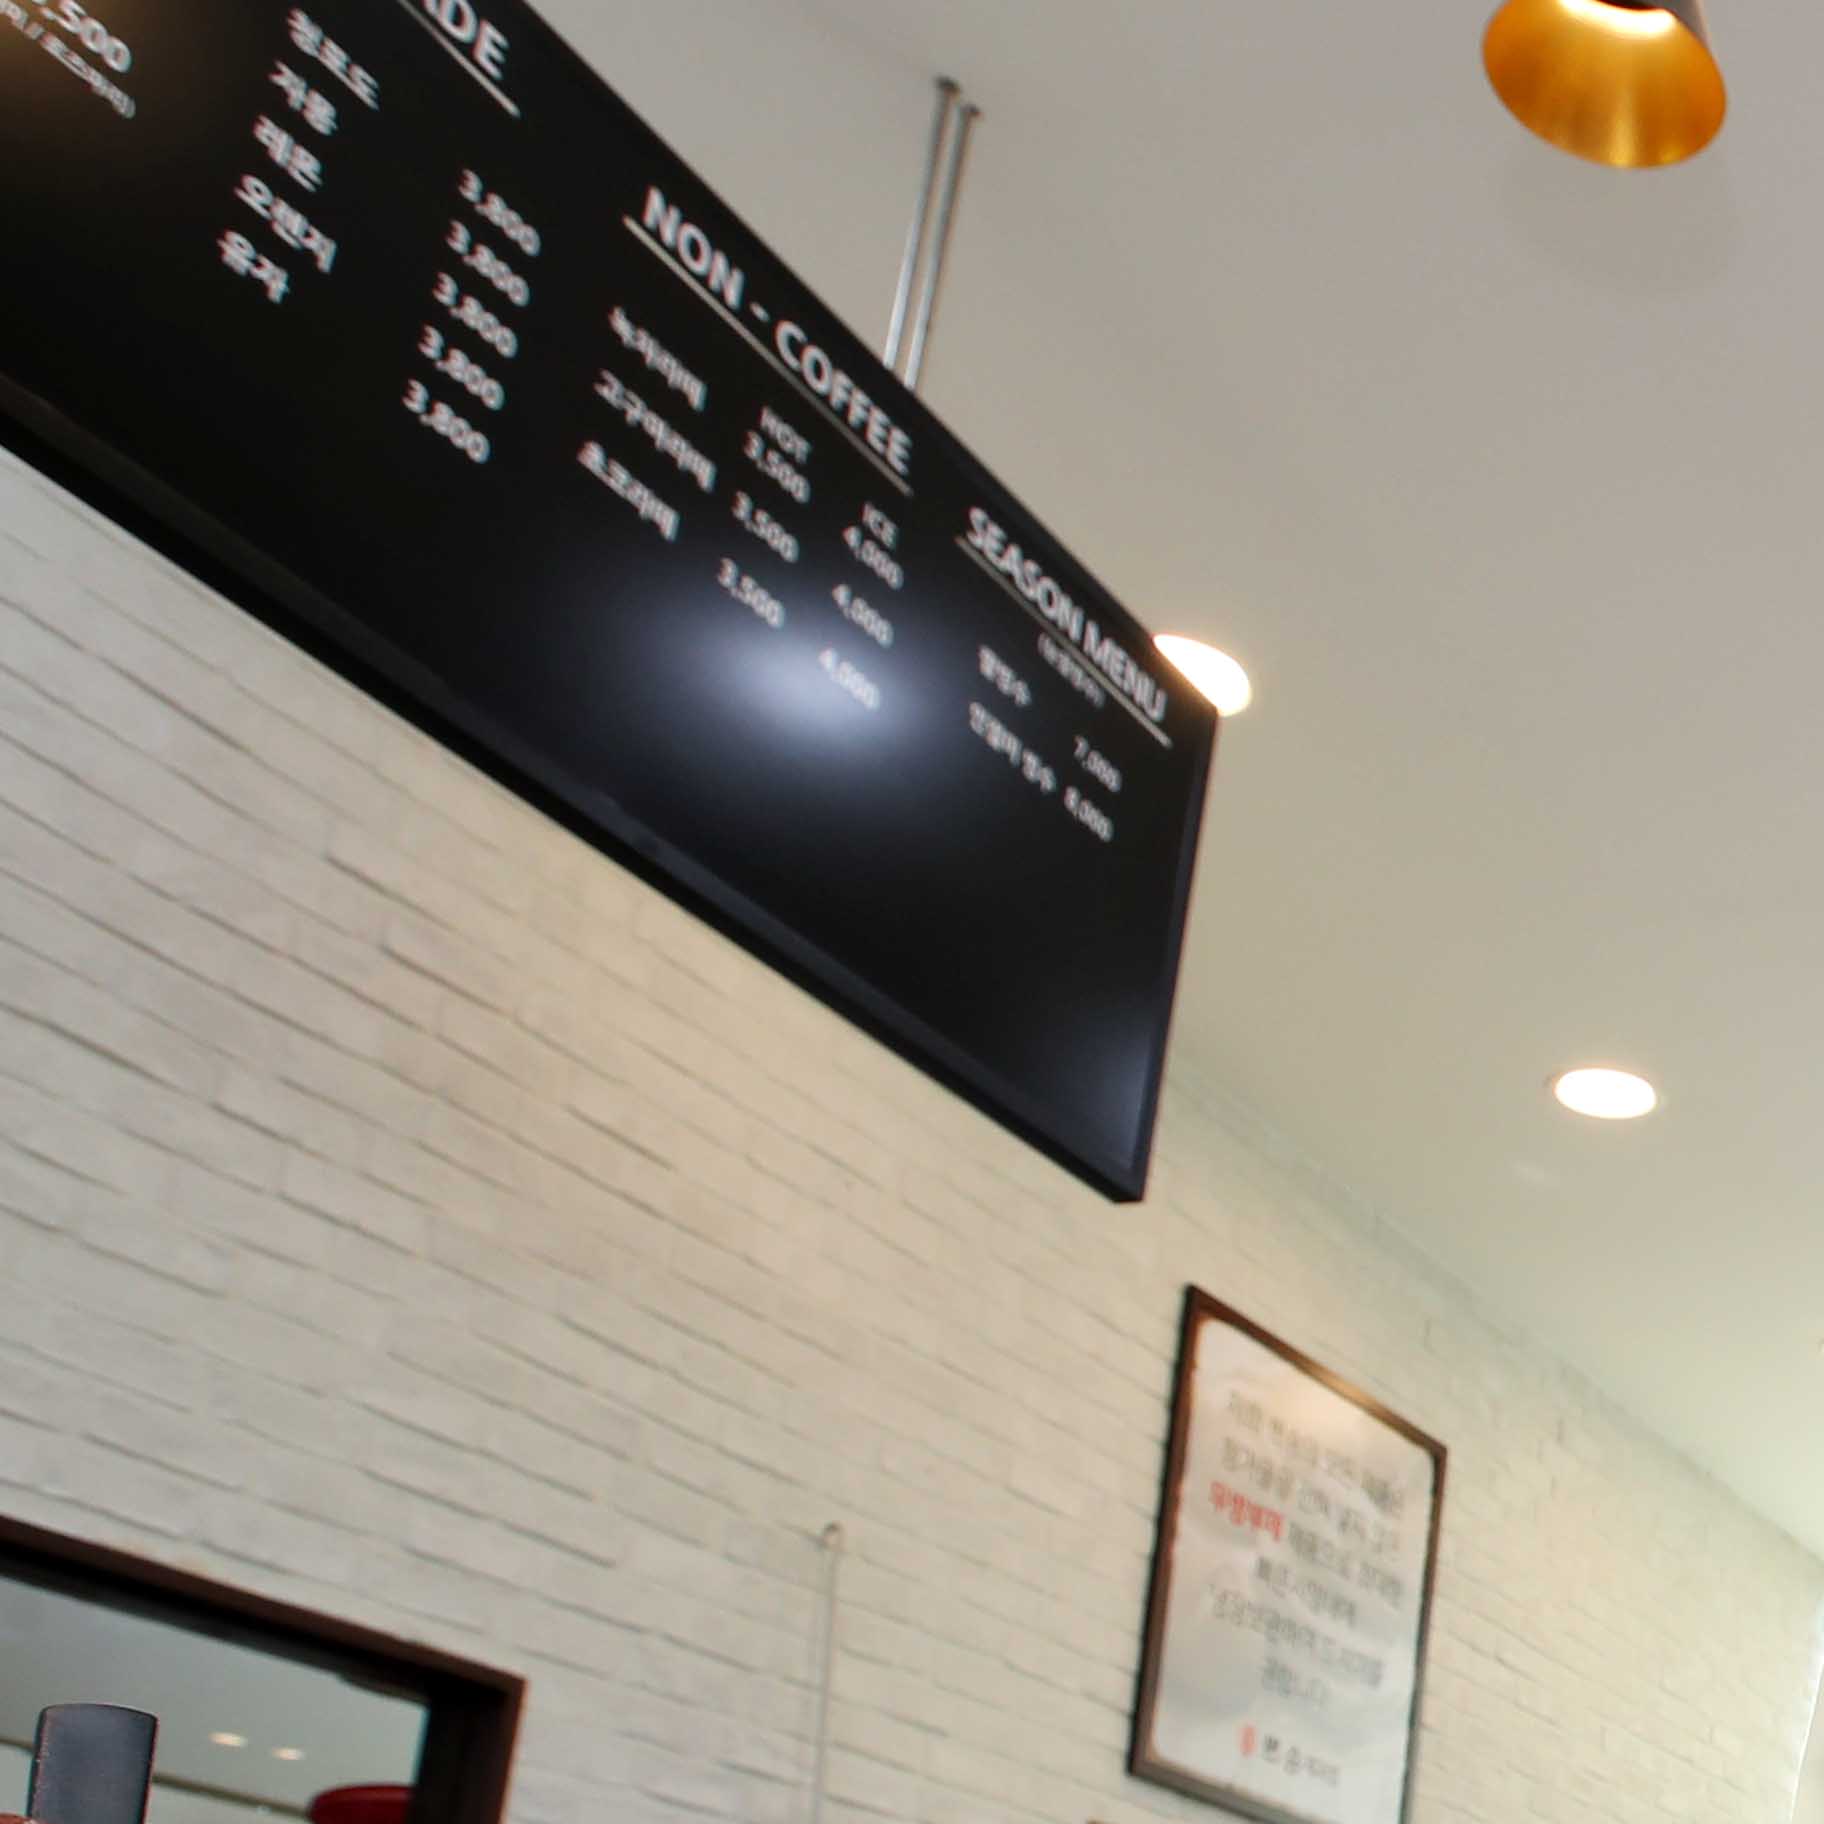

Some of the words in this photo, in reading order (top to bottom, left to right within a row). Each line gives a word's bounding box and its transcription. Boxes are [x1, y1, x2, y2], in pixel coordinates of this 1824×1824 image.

[32, 0, 132, 73] ,500
[420, 0, 509, 80] DE
[253, 114, 322, 192] 레몬
[234, 174, 337, 273] 오렌지
[216, 229, 289, 303] 유자
[643, 186, 744, 310] NON
[775, 319, 913, 474] COFFEE
[743, 431, 811, 502] 3,500
[760, 405, 812, 462] HOT
[862, 503, 899, 547] ICE
[731, 492, 799, 563] 3,500
[967, 506, 1084, 642] SEASON
[1084, 620, 1168, 723] MENU
